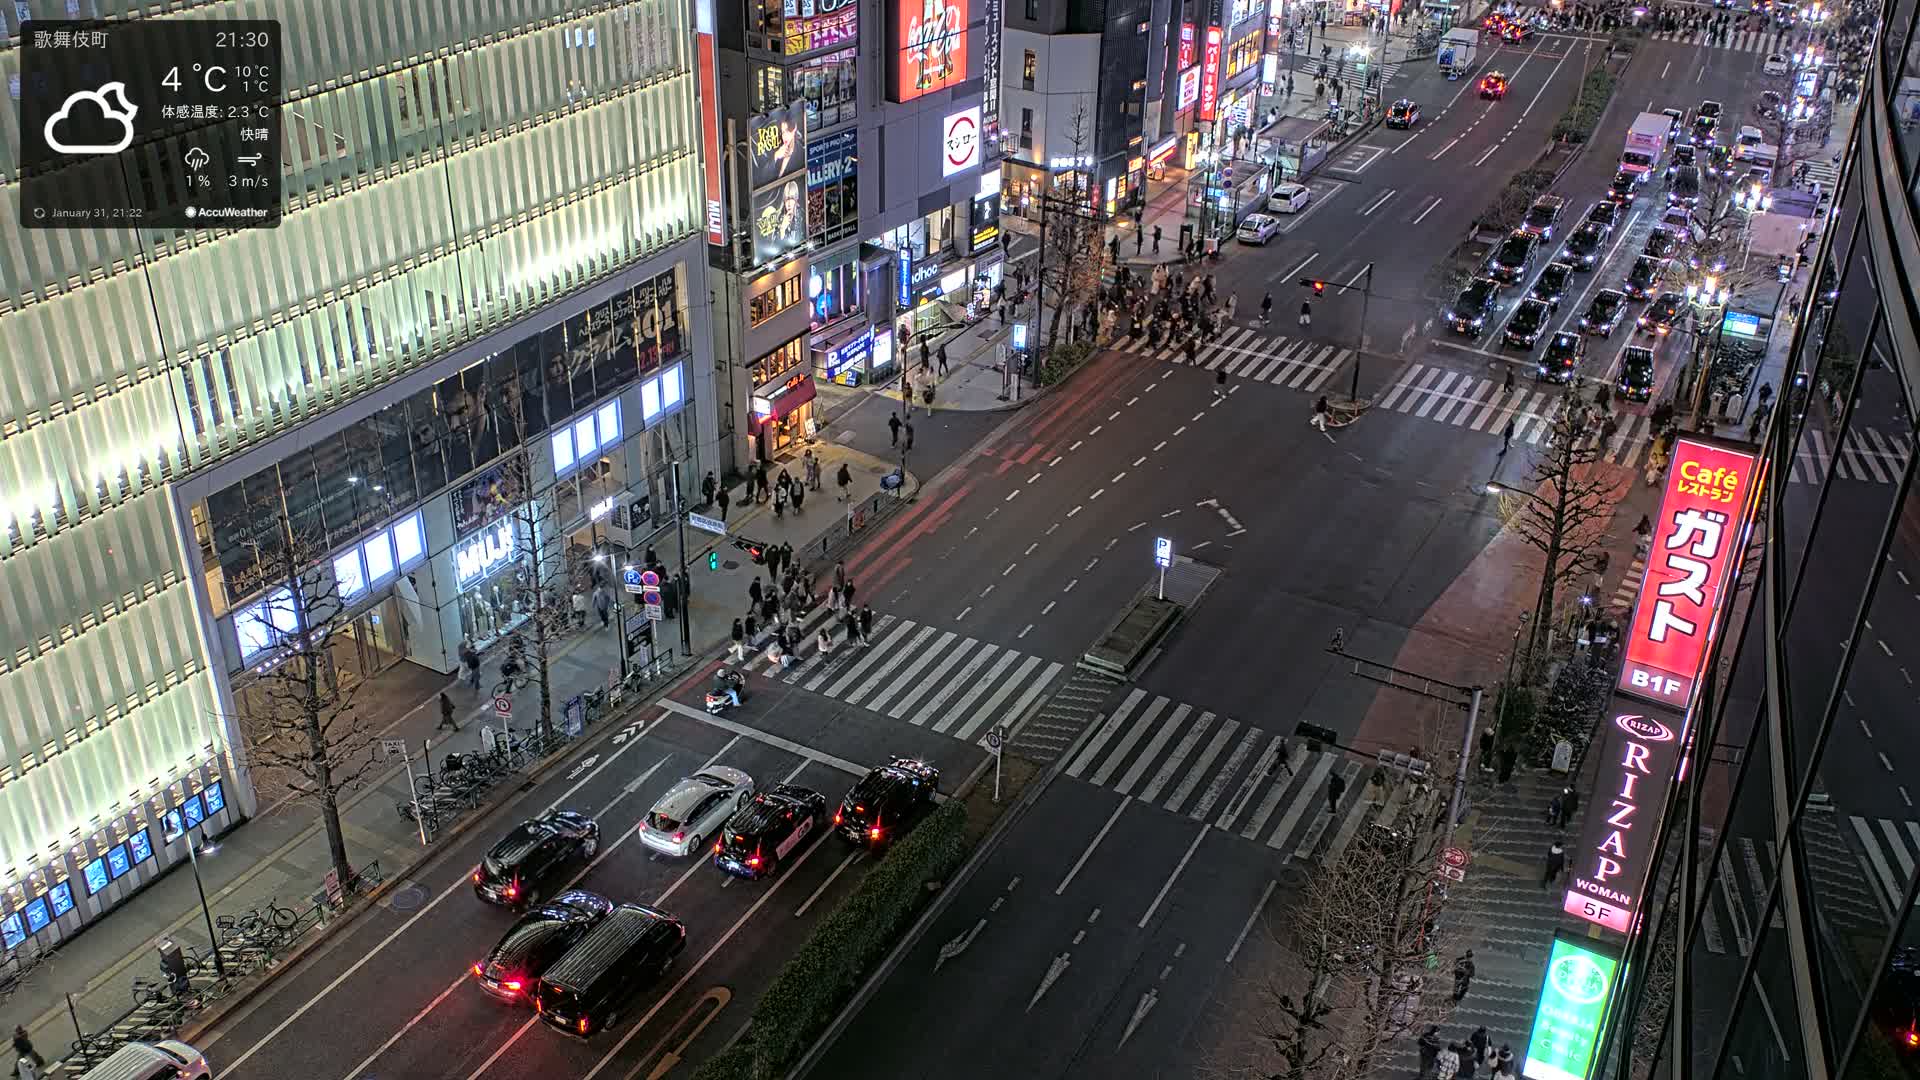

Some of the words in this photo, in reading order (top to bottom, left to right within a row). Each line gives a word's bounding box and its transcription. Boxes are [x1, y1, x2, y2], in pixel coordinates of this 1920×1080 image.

[1204, 46, 1218, 111] バーガーキング
[946, 134, 977, 150] スシロー
[708, 200, 721, 234] MUJI
[1680, 461, 1738, 488] Café
[1677, 480, 1735, 503] レストラン
[456, 523, 513, 582] MUJI
[1160, 540, 1167, 549] P
[1648, 509, 1727, 643] ガスト
[1631, 669, 1681, 696] B1F
[1629, 719, 1661, 735] RIZAP
[1593, 741, 1651, 882] RIZAP
[1576, 878, 1632, 906] WOMAN
[1583, 902, 1612, 921] 5F
